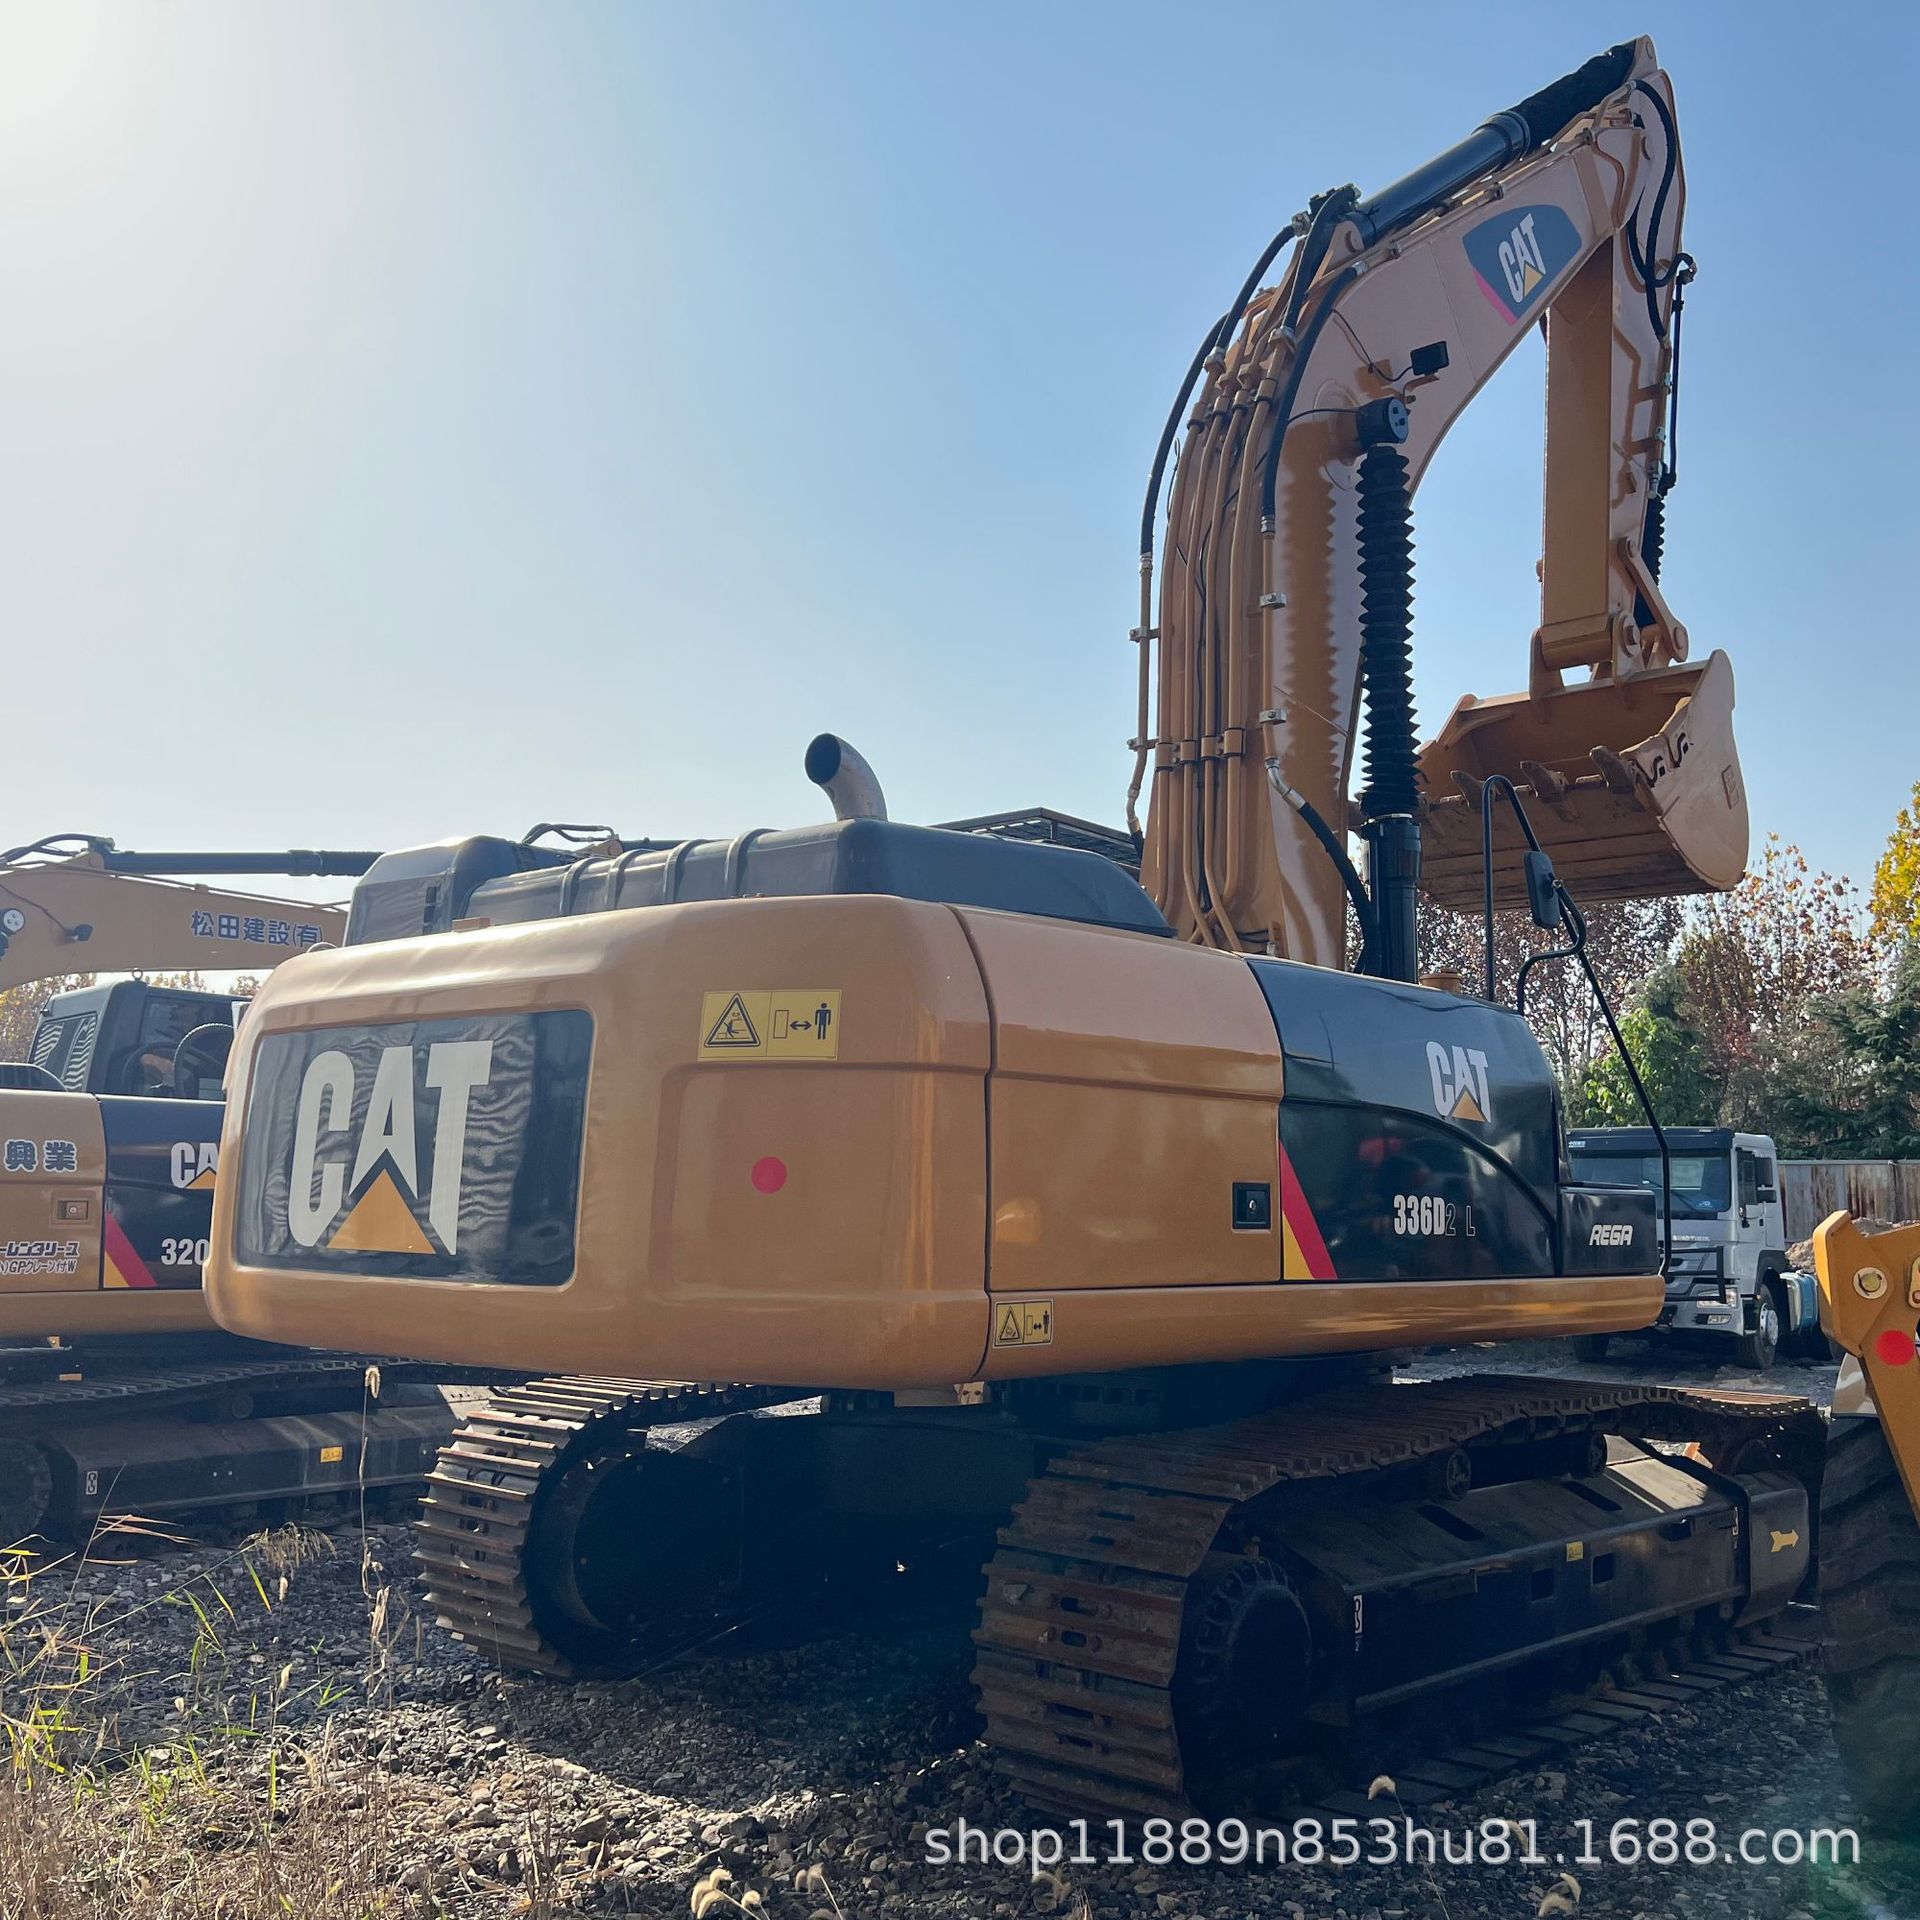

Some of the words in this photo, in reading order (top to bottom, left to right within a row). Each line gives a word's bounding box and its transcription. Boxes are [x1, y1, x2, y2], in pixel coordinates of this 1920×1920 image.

[1499, 213, 1546, 303] CAT
[190, 909, 323, 947] 松田建設(有)
[1425, 1041, 1492, 1123] CAT
[5, 1139, 77, 1172] 興業
[171, 1142, 219, 1189] CA
[289, 1040, 494, 1255] CAT
[1466, 1205, 1476, 1237] L
[1589, 1224, 1633, 1246] REGA
